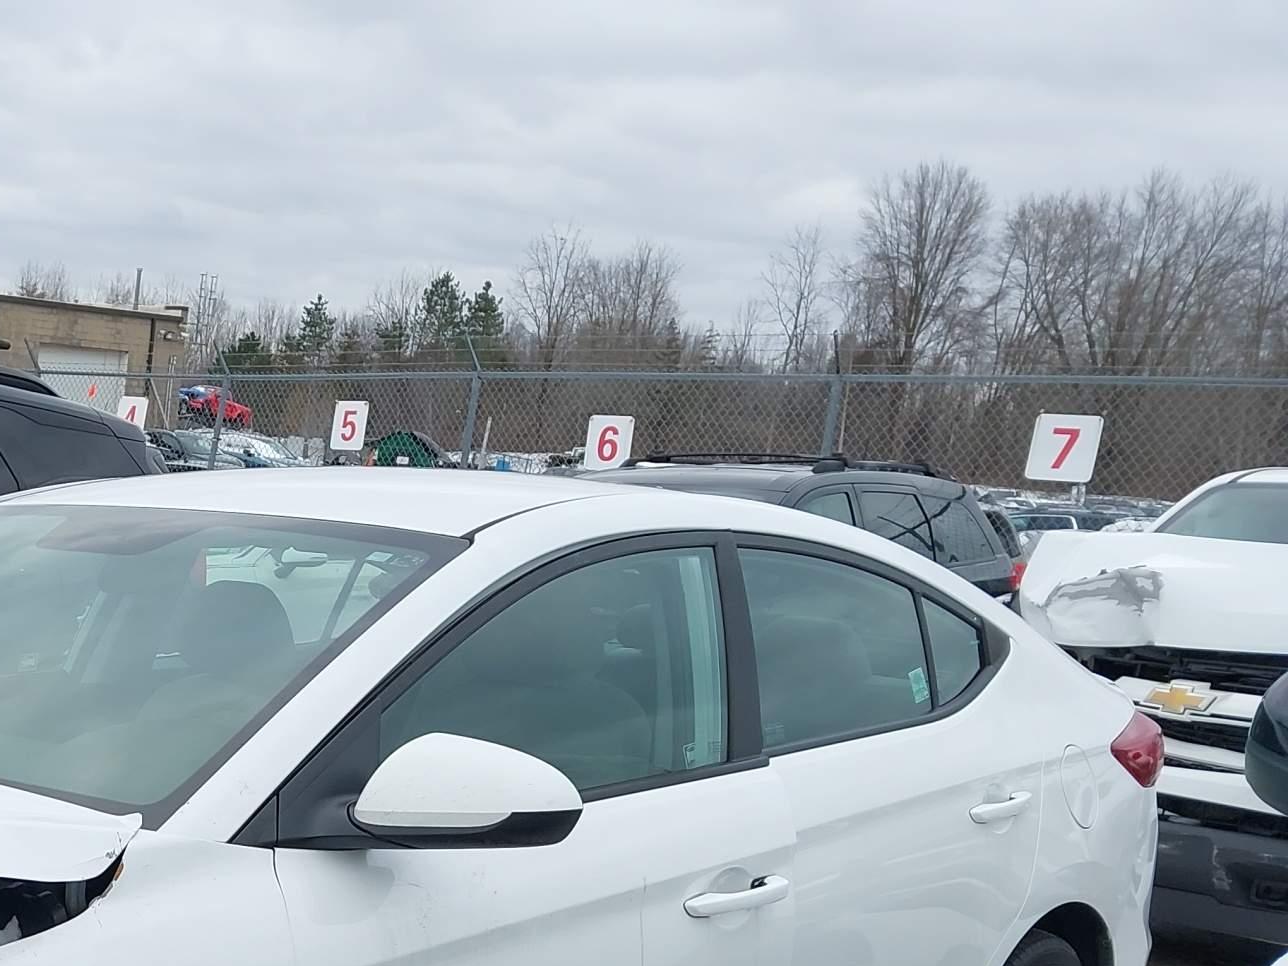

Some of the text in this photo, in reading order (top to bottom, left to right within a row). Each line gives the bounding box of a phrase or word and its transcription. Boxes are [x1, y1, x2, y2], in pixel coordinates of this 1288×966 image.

[340, 410, 358, 442] 5
[597, 425, 619, 462] 6
[1050, 427, 1081, 470] 7
